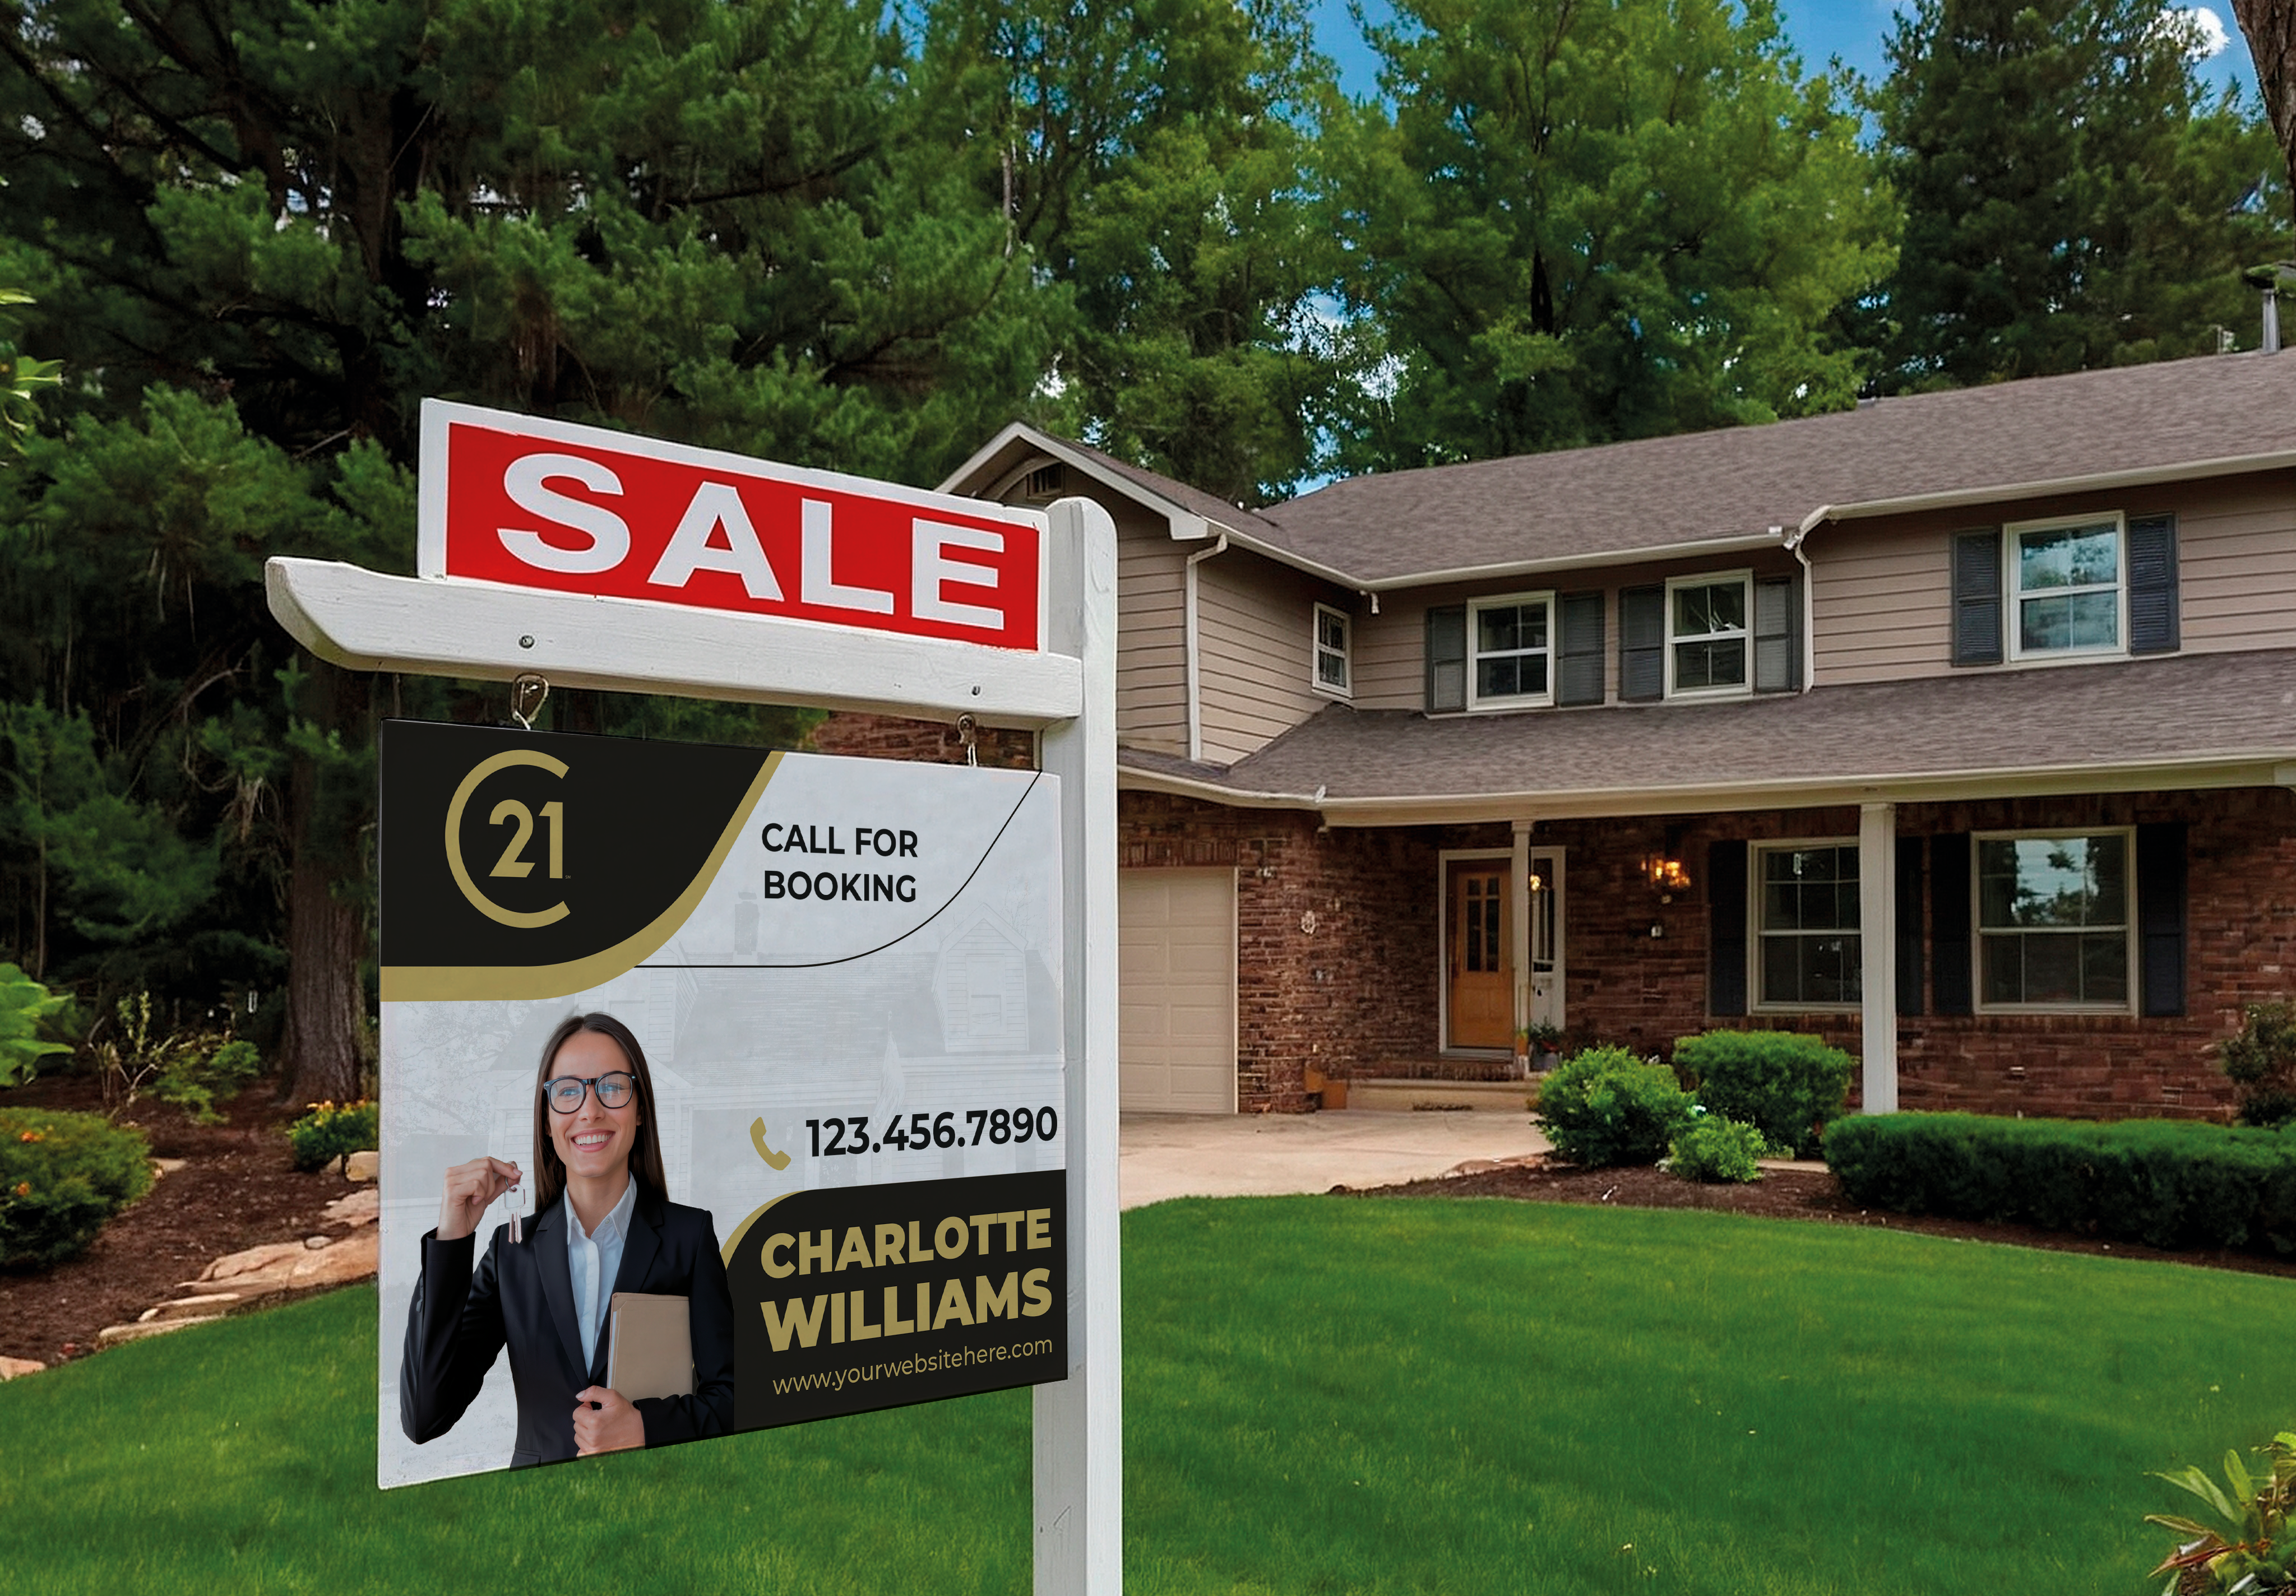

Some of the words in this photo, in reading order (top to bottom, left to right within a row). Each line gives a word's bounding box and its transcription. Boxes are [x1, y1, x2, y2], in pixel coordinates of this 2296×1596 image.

[496, 453, 1005, 630] SALE
[489, 799, 563, 879] 21
[762, 823, 845, 855] CALL
[855, 828, 918, 857] FOR
[765, 870, 916, 903] BOOKING
[806, 1106, 1058, 1157] 123.456.7890
[761, 1208, 1052, 1279] CHARLOTTE
[760, 1268, 1052, 1352] WILLIAMS
[772, 1339, 1052, 1395] www.yourwebsitehere.com
